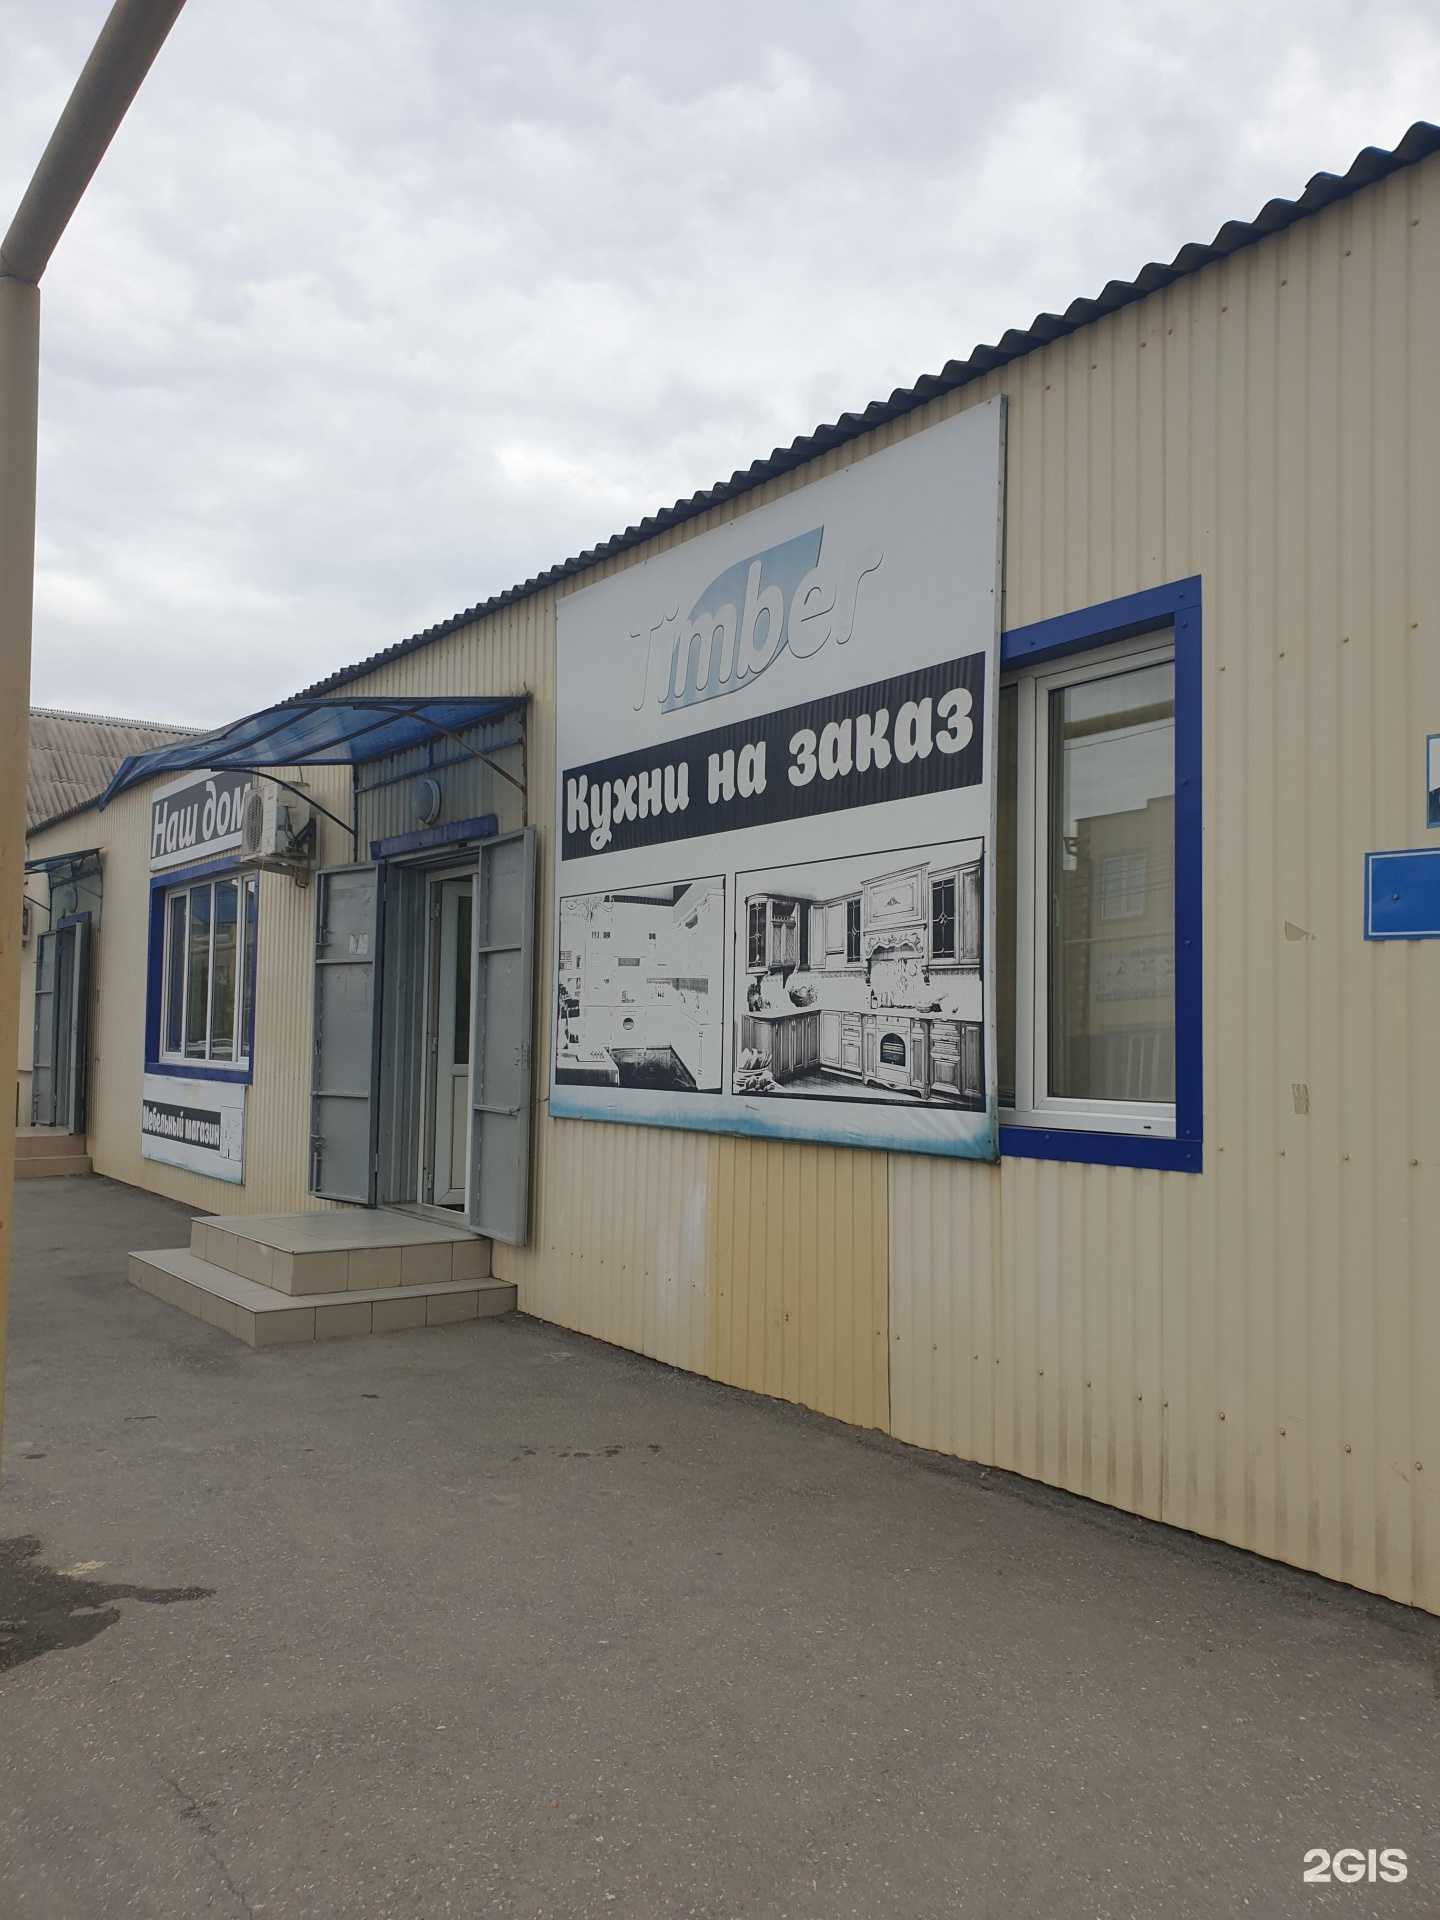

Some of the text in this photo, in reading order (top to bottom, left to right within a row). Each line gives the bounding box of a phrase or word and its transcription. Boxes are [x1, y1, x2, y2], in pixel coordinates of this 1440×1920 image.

[626, 548, 885, 712] Timber
[151, 780, 251, 858] Наш дом
[566, 687, 974, 851] Кухни на заказ
[143, 1104, 220, 1147] Мебельный магазин
